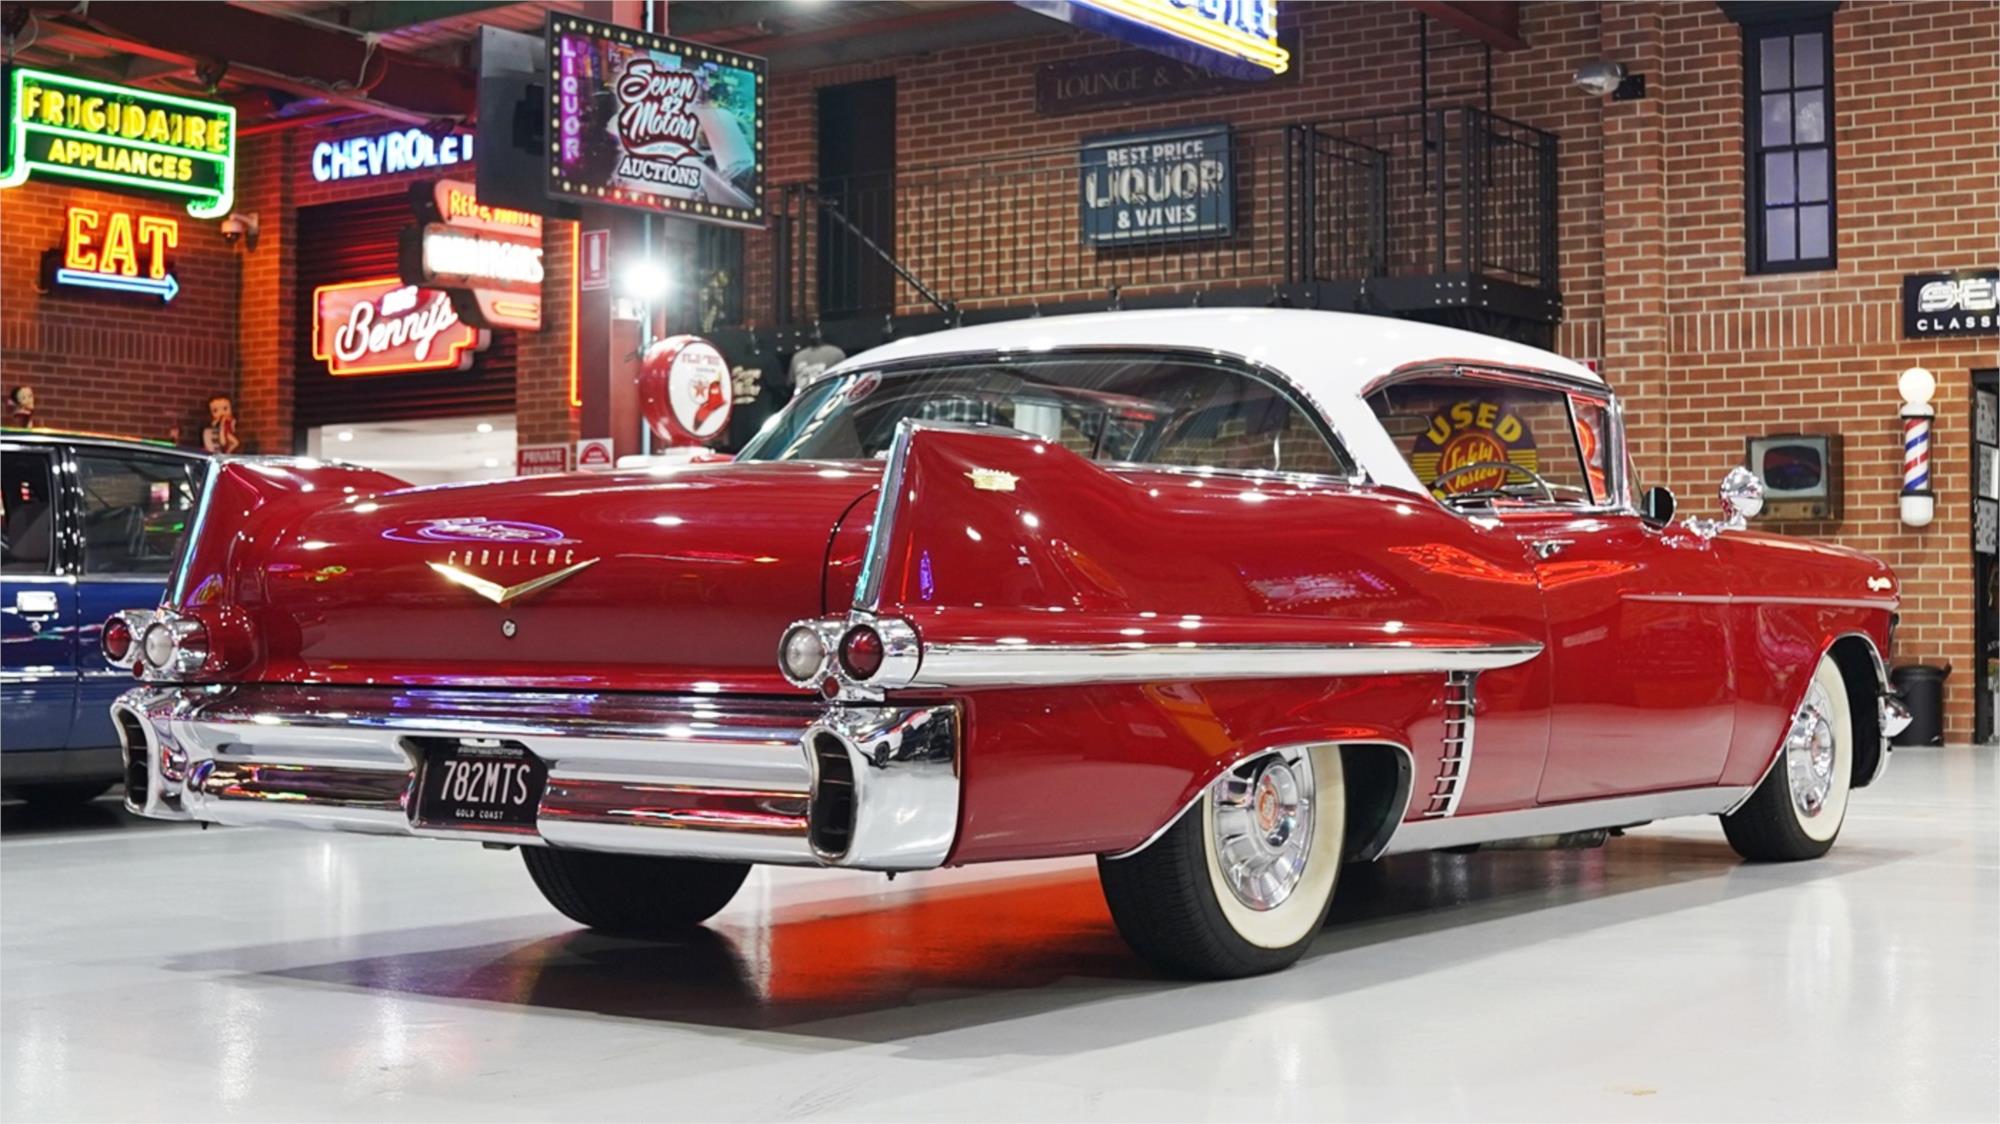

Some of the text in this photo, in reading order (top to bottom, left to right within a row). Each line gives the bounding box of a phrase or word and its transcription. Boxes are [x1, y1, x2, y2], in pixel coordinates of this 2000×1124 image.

[561, 37, 580, 160] LIQUOR
[620, 61, 696, 104] Seven
[1057, 69, 1139, 100] LOUNGE
[1153, 66, 1171, 88] &
[23, 86, 229, 153] FRIGIDAIRE
[621, 101, 697, 141] Motors
[48, 138, 193, 181] APPLIANCES
[619, 157, 699, 187] AUCTIONS
[1107, 139, 1204, 168] BEST PRICE
[1085, 160, 1224, 209] LIQUOR
[1117, 204, 1197, 229] & WINES
[66, 207, 178, 279] EAT
[1917, 278, 2000, 313] SE
[334, 290, 458, 361] Benny's
[1426, 402, 1523, 446] USED
[447, 548, 575, 566] CADILLAC
[440, 760, 531, 805] 782MTS
[455, 808, 504, 820] GOLD COAST
